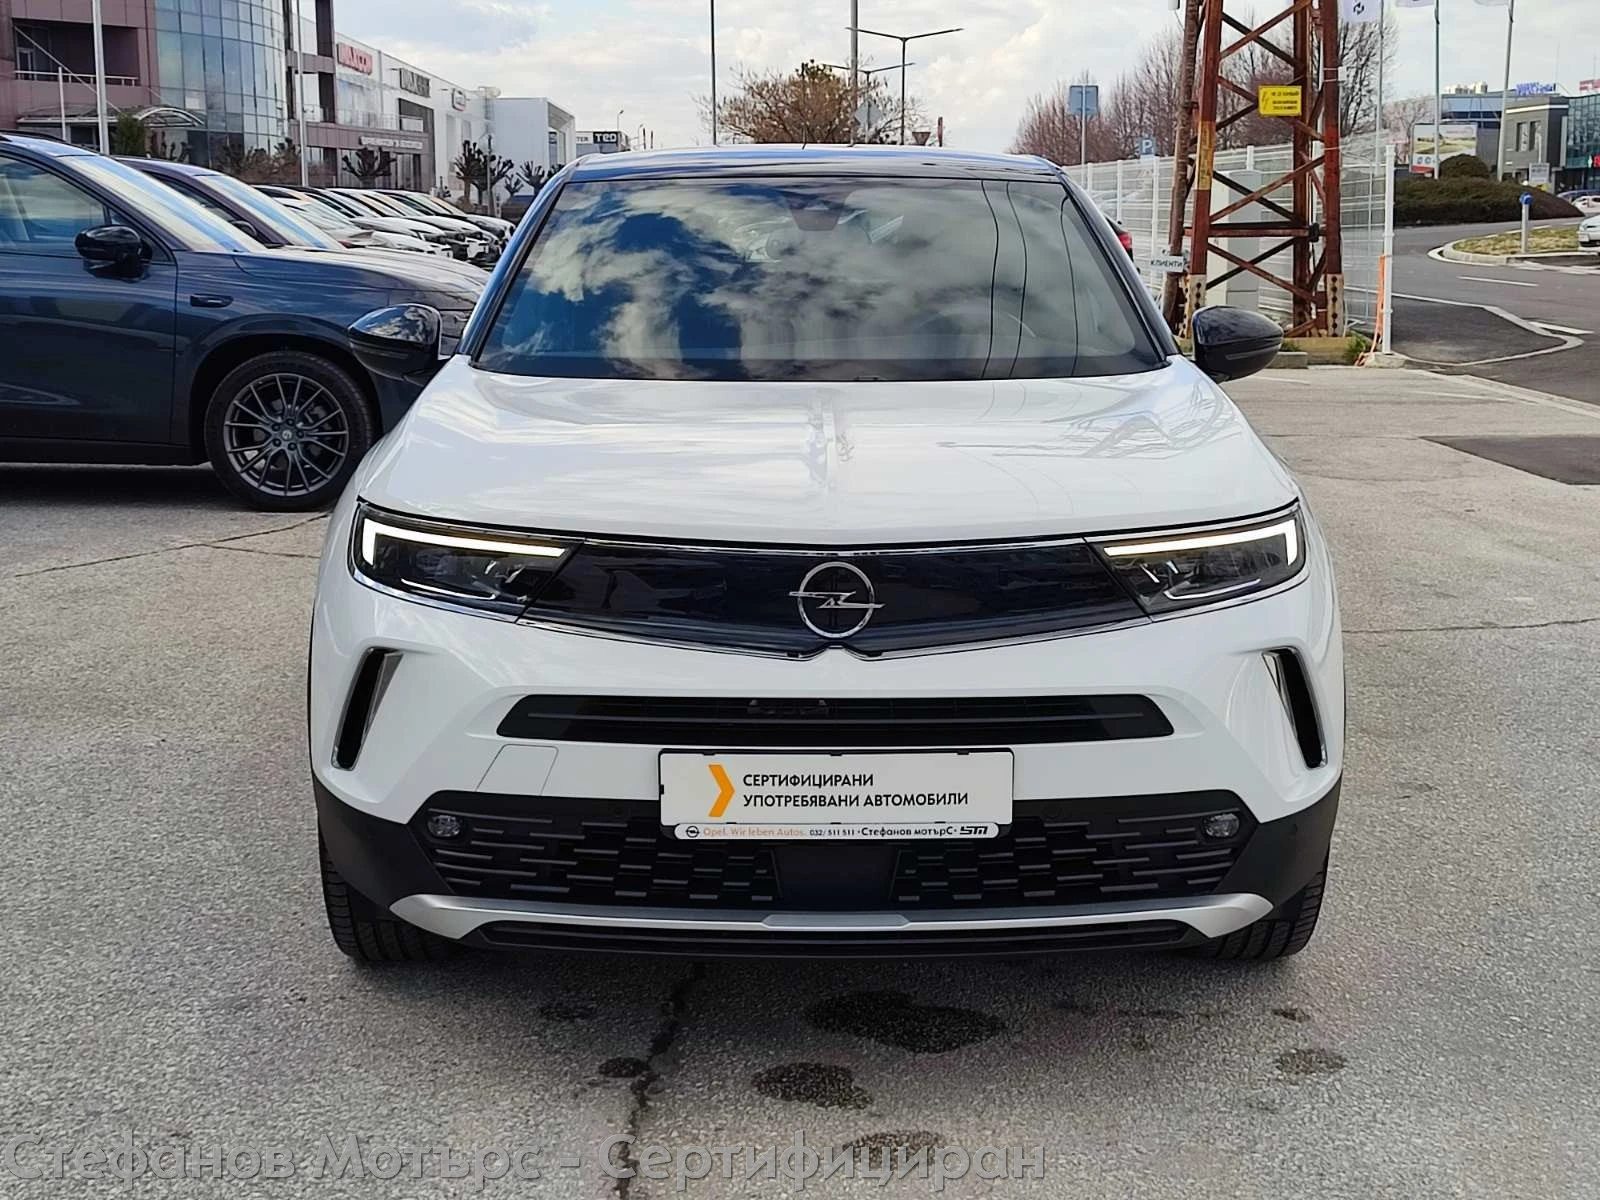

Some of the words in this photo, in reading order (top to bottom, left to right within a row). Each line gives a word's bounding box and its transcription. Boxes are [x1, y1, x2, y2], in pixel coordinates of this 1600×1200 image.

[1142, 139, 1153, 153] P
[743, 774, 874, 788] СЕРТИФИЦИРАНИ
[743, 794, 860, 807] УПОТРЕБЯВАНИ
[863, 792, 969, 807] АВТОМОБИЛИ
[730, 827, 747, 837] Wir
[749, 826, 775, 837] leben
